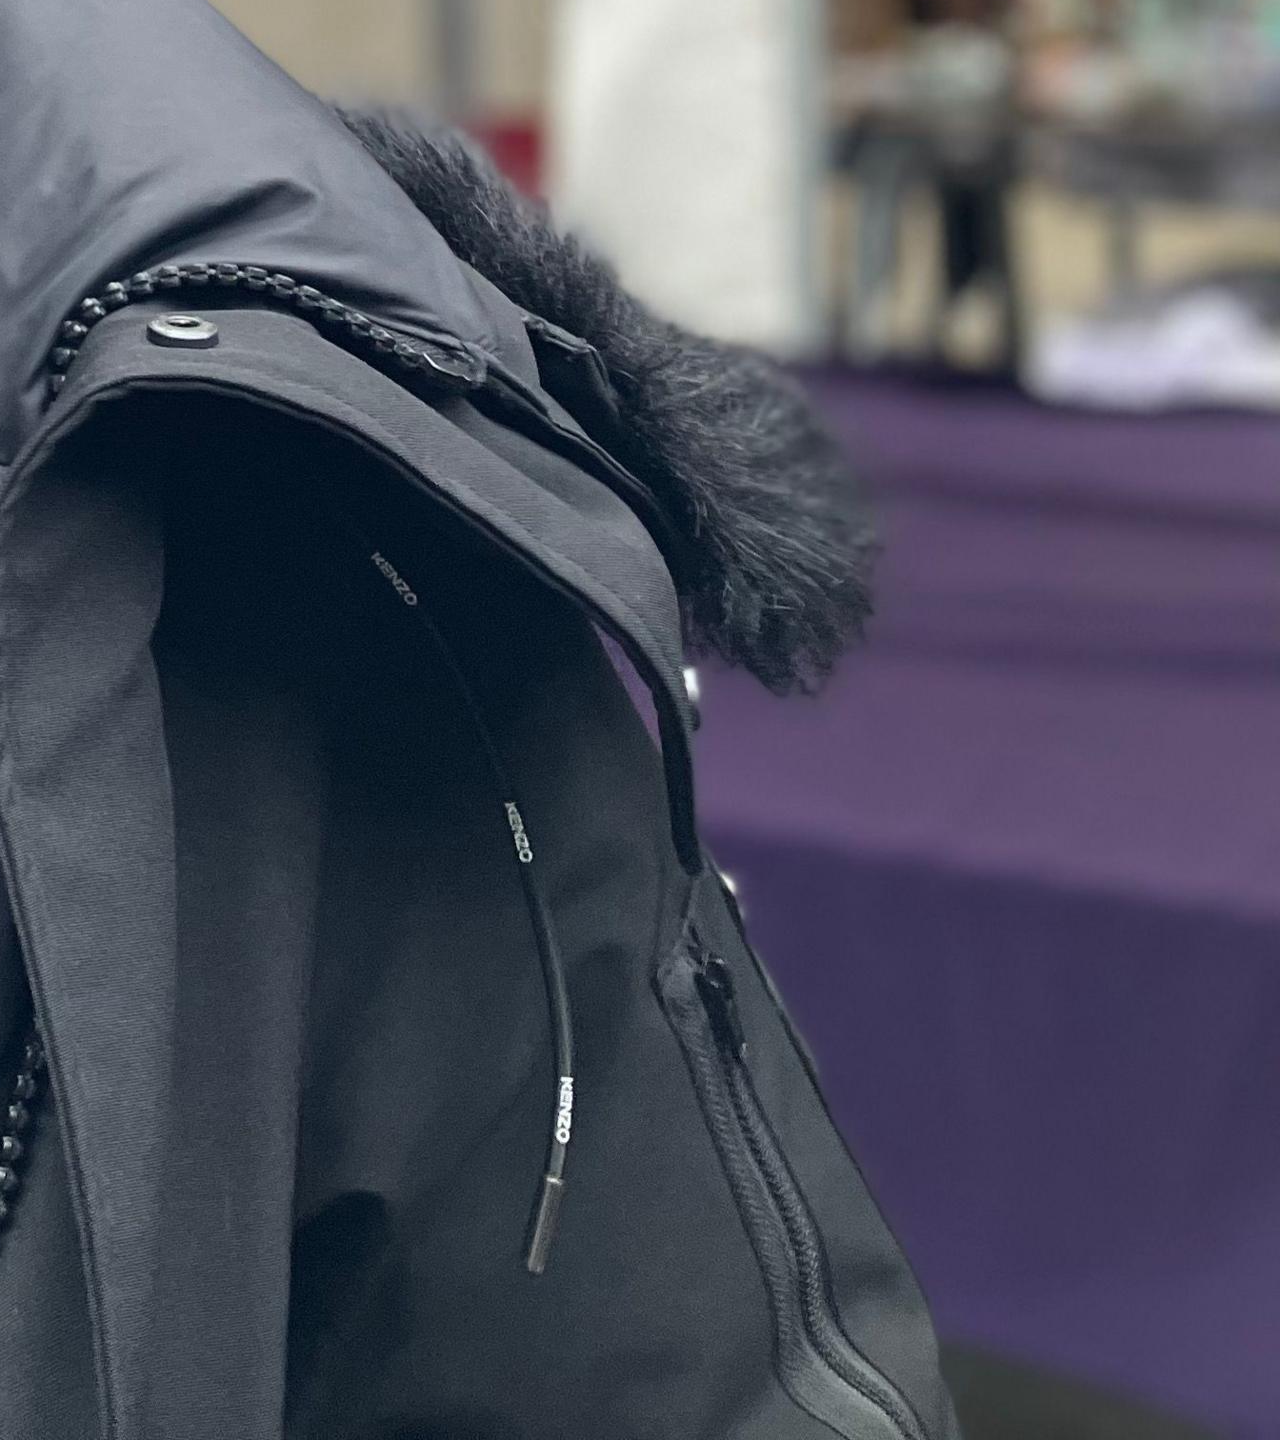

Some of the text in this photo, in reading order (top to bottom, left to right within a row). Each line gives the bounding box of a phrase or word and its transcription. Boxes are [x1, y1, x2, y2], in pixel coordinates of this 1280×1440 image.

[371, 552, 418, 606] KENZO
[504, 802, 533, 863] KENZO
[556, 1076, 574, 1144] KENZO
